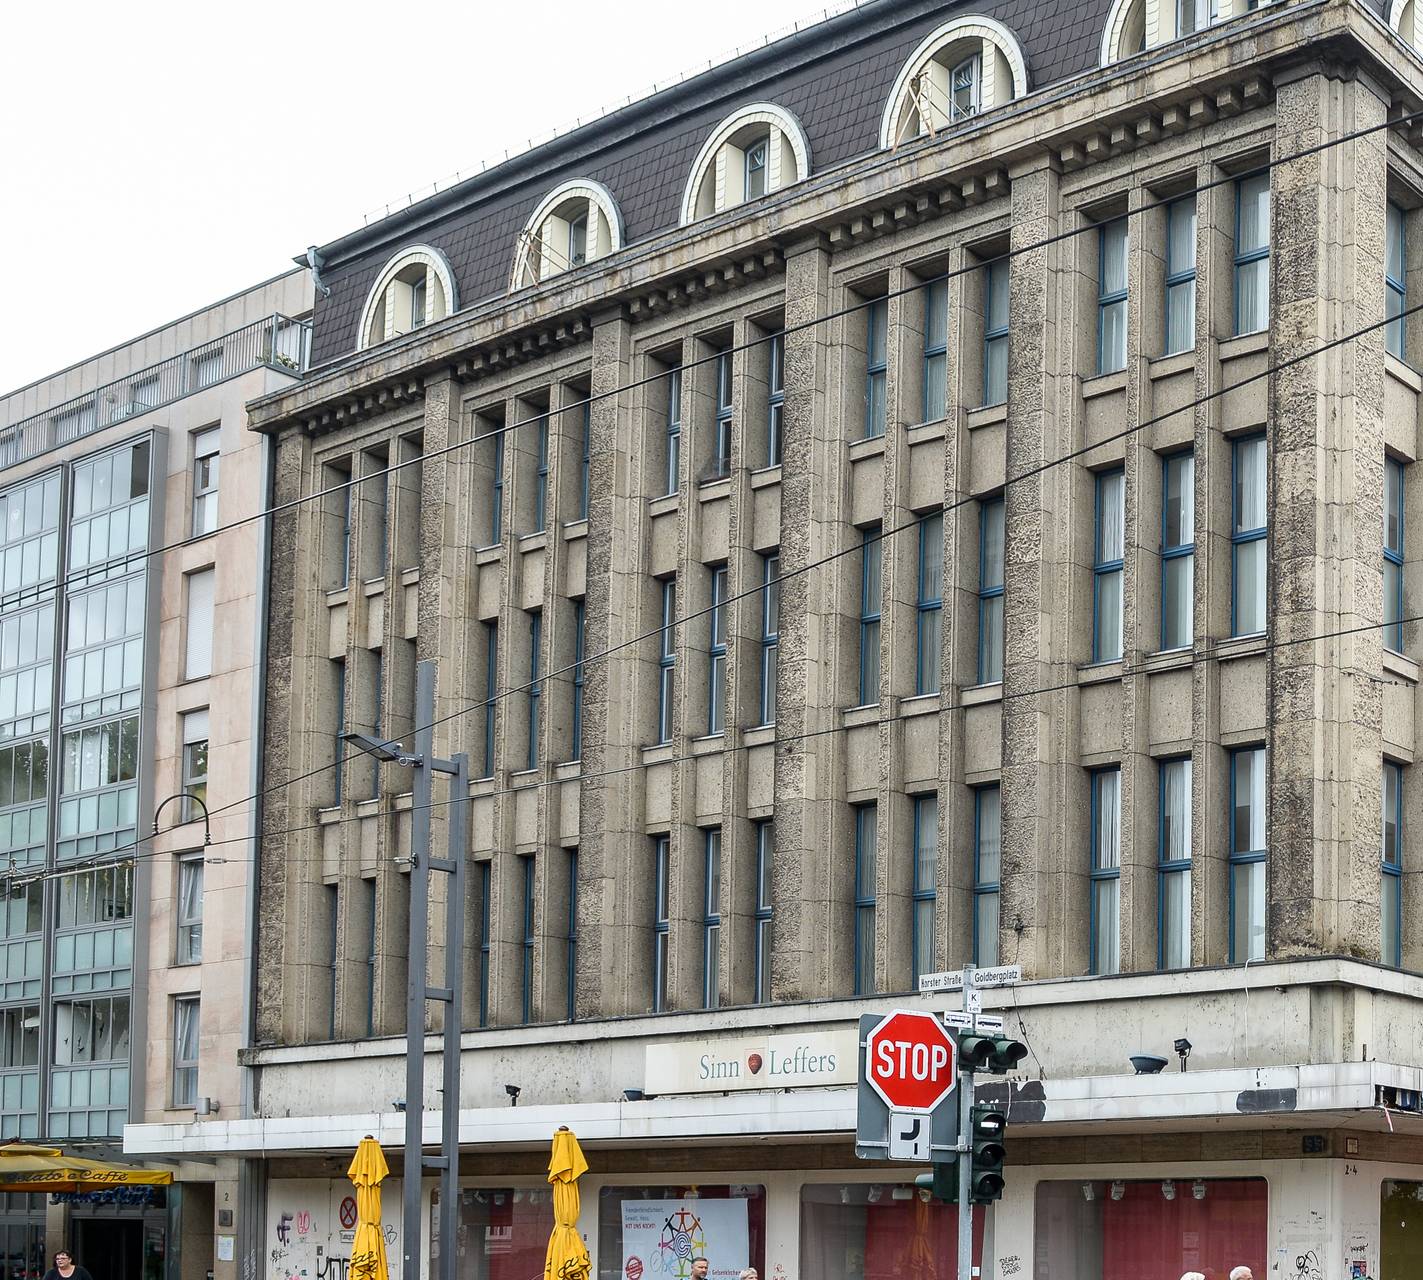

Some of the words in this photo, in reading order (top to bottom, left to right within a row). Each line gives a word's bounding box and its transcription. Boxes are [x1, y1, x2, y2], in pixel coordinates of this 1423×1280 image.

[944, 974, 962, 986] Straße
[974, 970, 1018, 983] Goldbergplatz
[699, 1054, 740, 1080] Sinn
[769, 1046, 836, 1076] Leffers
[876, 1039, 948, 1082] STOP
[224, 1192, 230, 1202] 2
